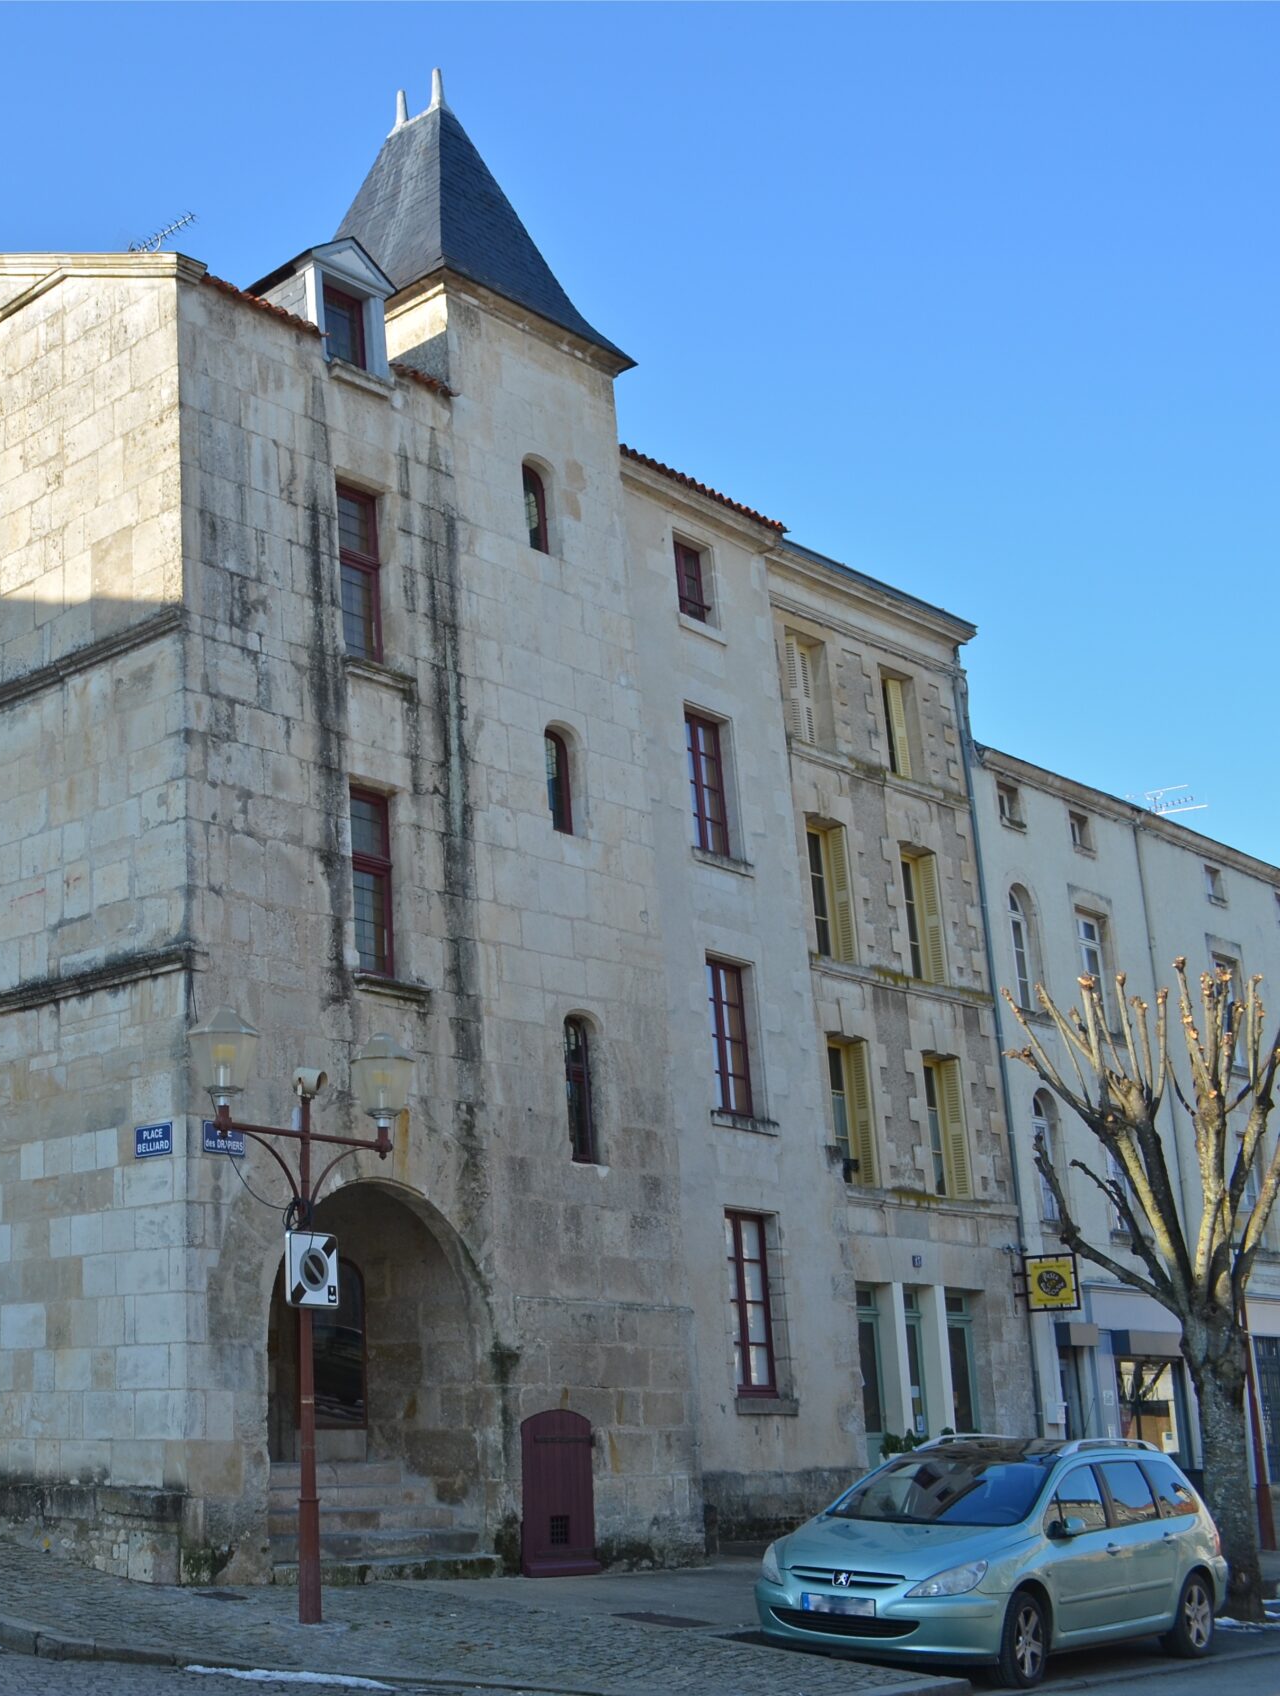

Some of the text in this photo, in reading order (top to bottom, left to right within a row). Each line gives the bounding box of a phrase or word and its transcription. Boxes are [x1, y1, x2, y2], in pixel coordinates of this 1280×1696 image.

[143, 1128, 162, 1140] PLACE
[137, 1140, 169, 1153] BELLIARD
[206, 1138, 216, 1148] des
